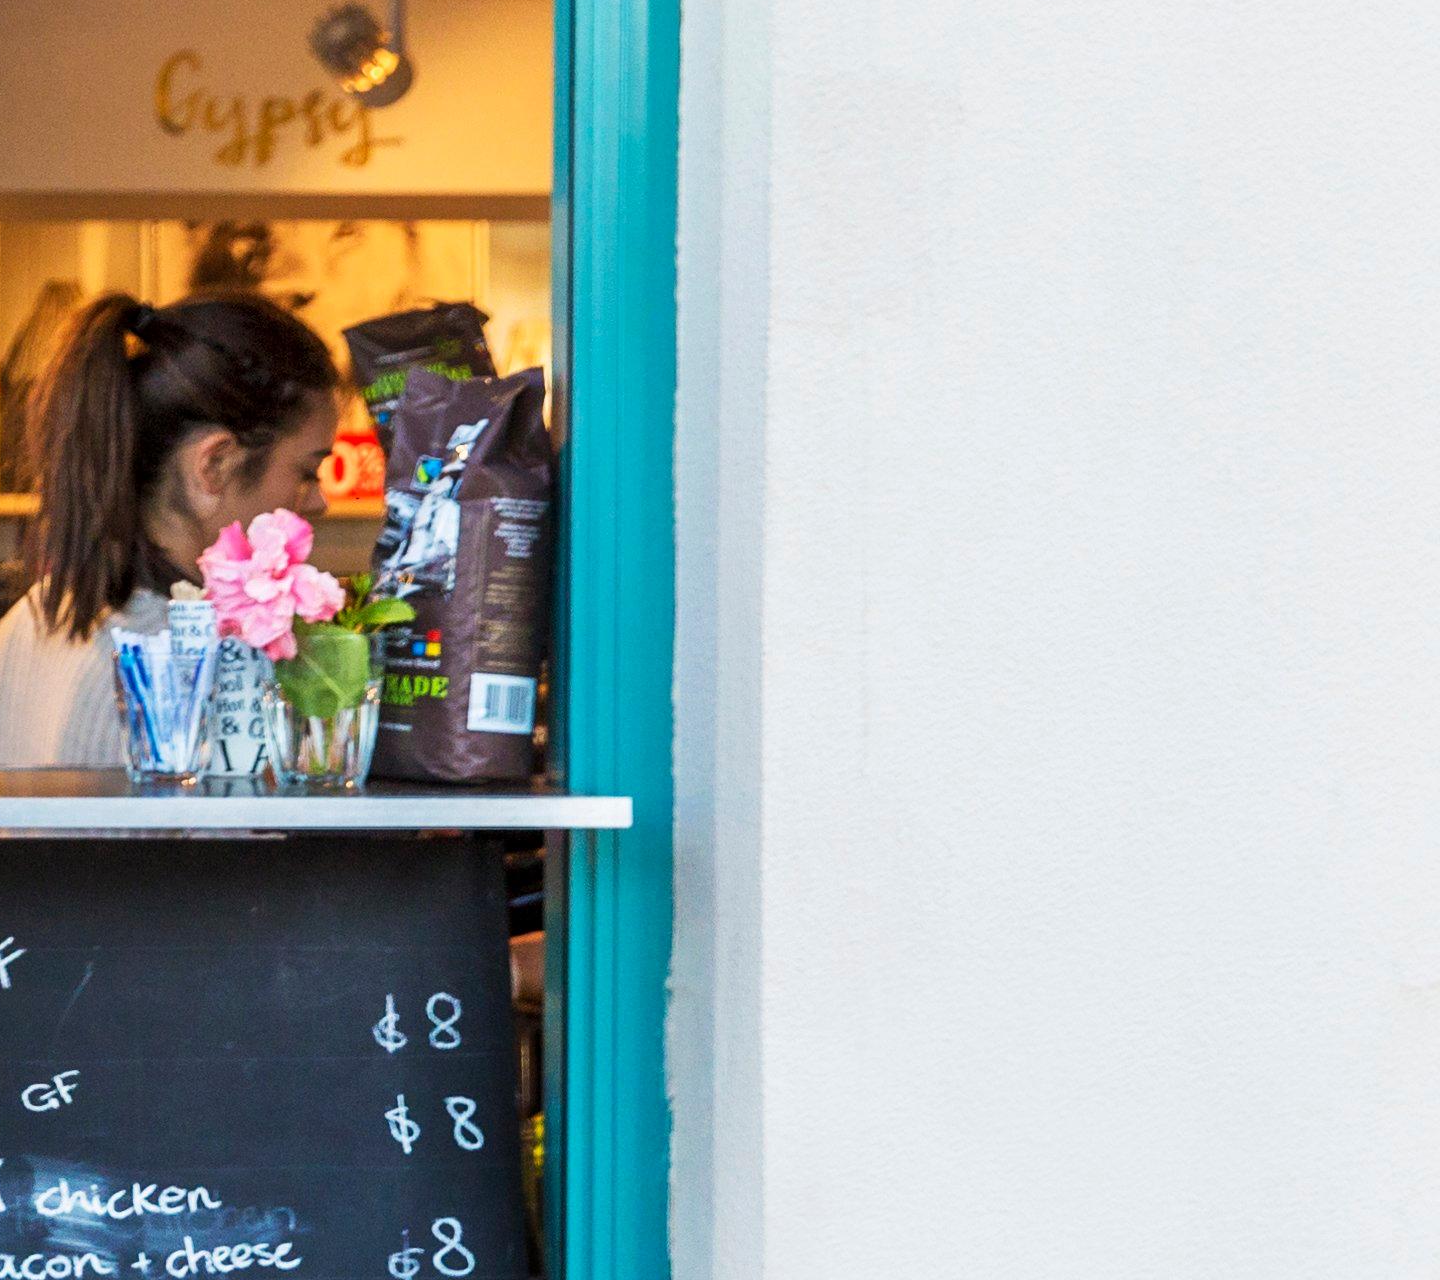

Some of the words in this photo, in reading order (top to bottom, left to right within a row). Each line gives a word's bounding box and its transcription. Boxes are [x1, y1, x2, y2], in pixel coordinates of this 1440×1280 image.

[20, 1068, 81, 1114] GF
[35, 1178, 223, 1220] chicken
[165, 1236, 302, 1279] cheese
